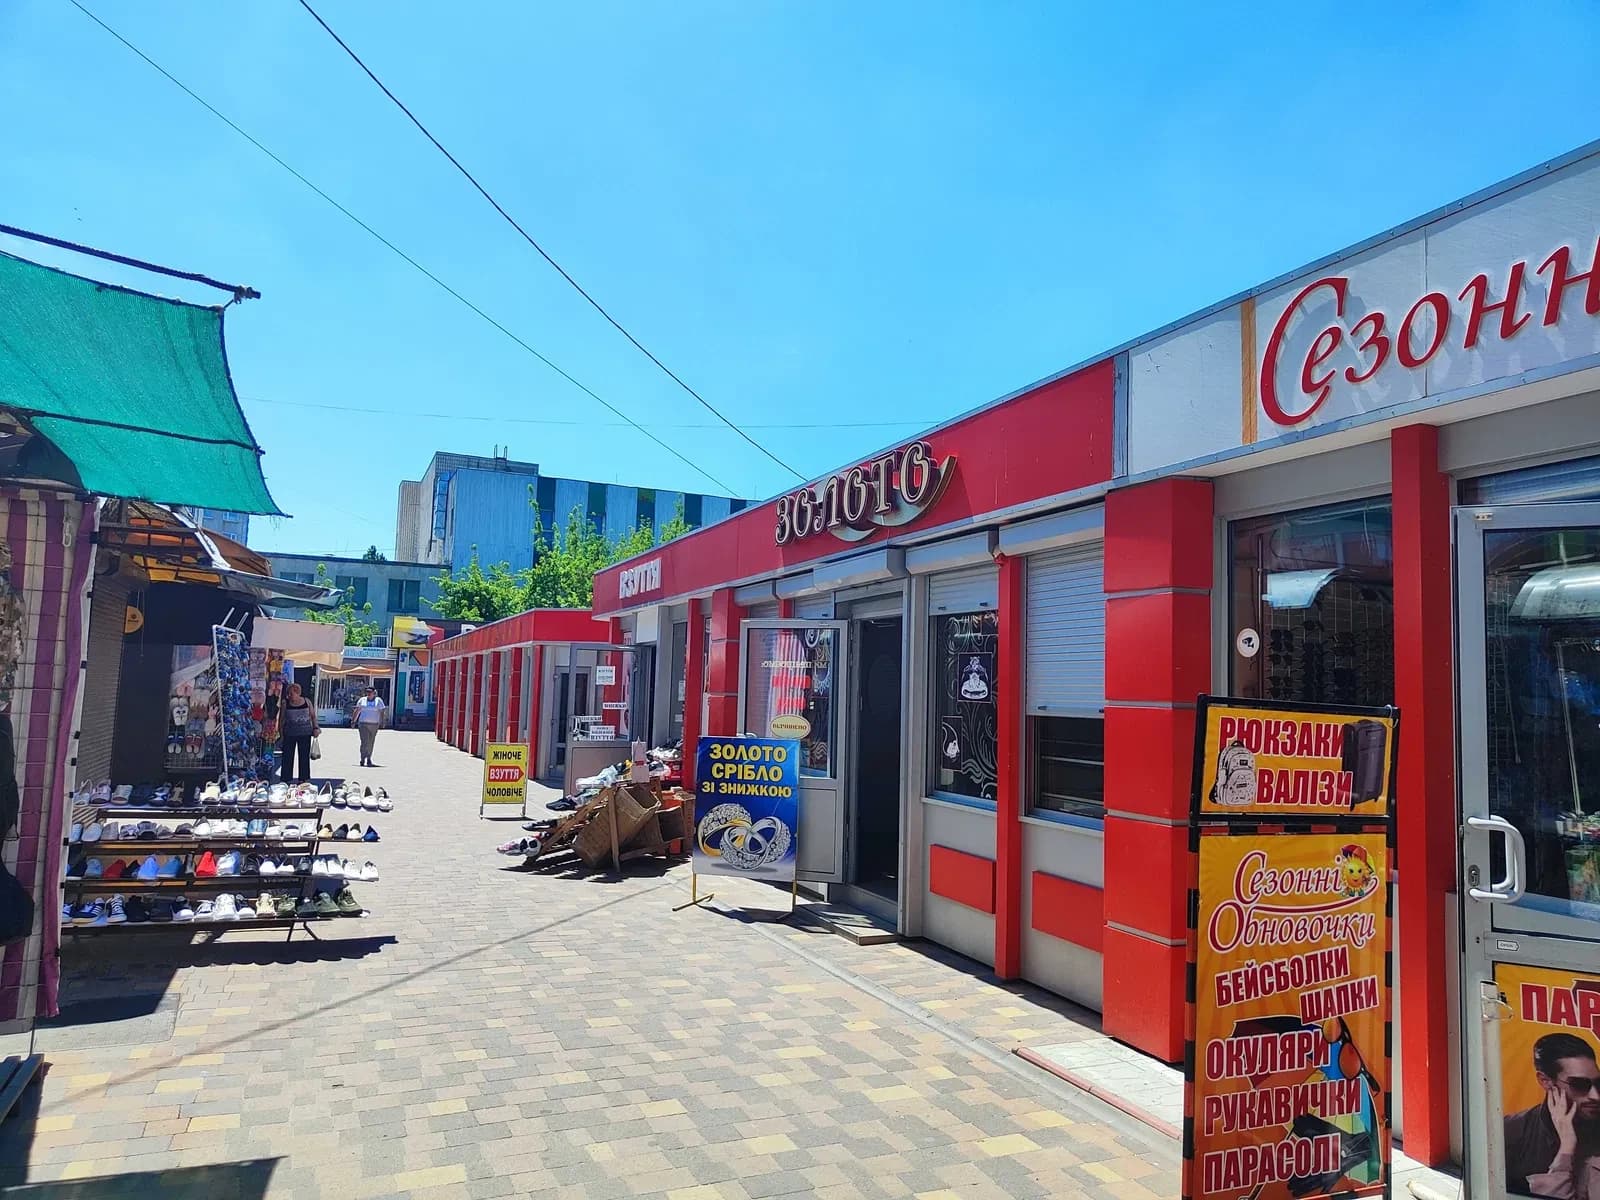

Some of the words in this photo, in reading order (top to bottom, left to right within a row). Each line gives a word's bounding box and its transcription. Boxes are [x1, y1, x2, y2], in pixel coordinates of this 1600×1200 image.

[775, 440, 936, 545] ЗОЛОТО
[619, 557, 662, 600] ВЗУТТЯ
[492, 751, 522, 761] ЖІНОЧЕ
[709, 743, 787, 763] ЗОЛОТО
[1218, 716, 1345, 760] РЮКЗАКИ
[486, 787, 523, 797] ЧОЛОВІЧЕ
[490, 768, 519, 780] ВЗУТТЯ
[702, 781, 716, 794] ЗІ
[719, 782, 792, 798] ЗНИЖКОЮ
[711, 762, 783, 782] СРІБЛО
[1255, 768, 1353, 807] ВАЛІЗИ
[1235, 850, 1343, 905] Сезонні
[1208, 899, 1376, 953] Обновочки
[1215, 946, 1351, 1008] БЕЙСБОЛКИ
[1300, 975, 1380, 1026] ШАПКИ
[1520, 982, 1600, 1030] ПАР
[1206, 1029, 1332, 1081] ОКУЛЯРИ
[1204, 1077, 1363, 1137] РУКАВИЧКИ
[1203, 1132, 1342, 1195] ПАРАСОЛІ
